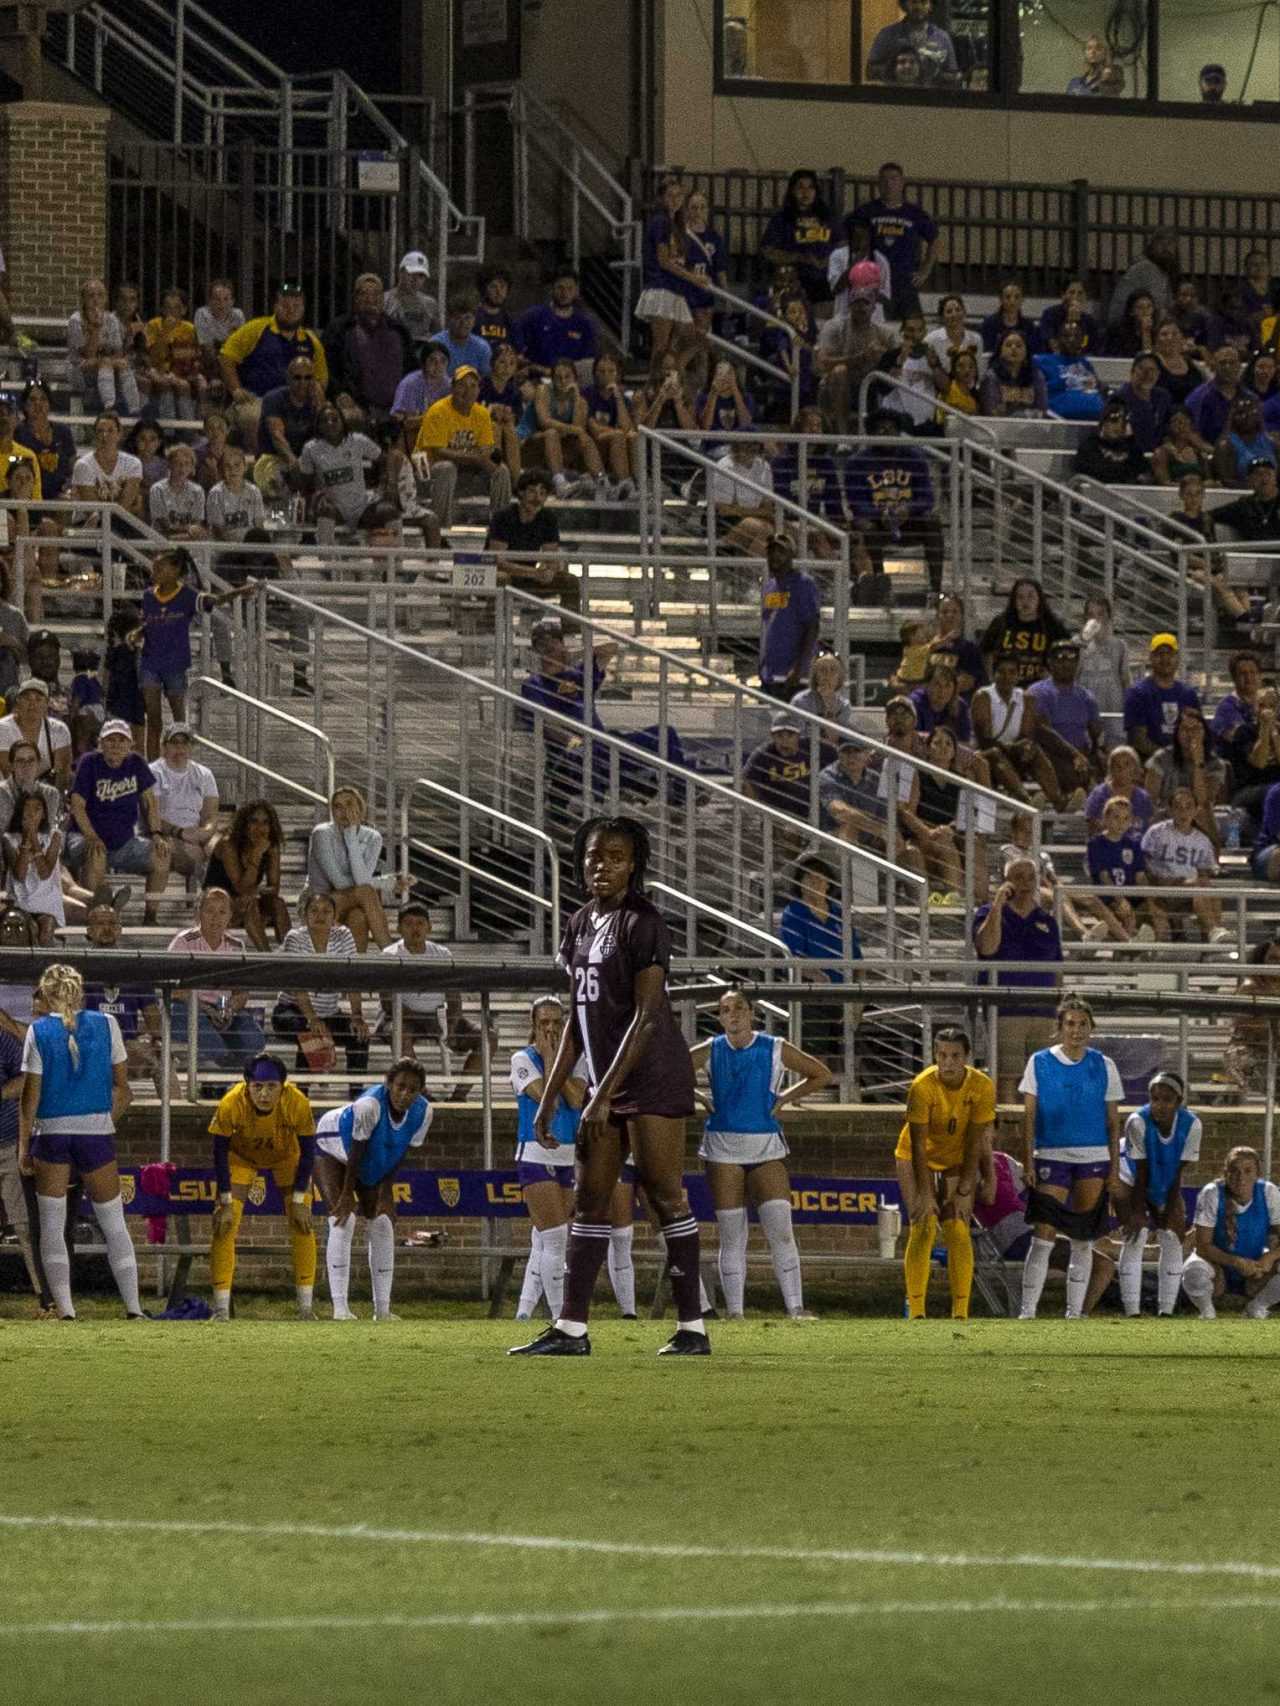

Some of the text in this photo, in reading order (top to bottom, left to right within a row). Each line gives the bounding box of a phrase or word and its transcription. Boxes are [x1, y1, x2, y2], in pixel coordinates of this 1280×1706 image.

[867, 468, 911, 490] LSU
[464, 574, 486, 586] 202
[1001, 630, 1048, 652] LSU
[96, 775, 138, 802] Tigers
[1159, 845, 1208, 867] LSU
[575, 966, 600, 1002] 26
[486, 1183, 526, 1204] LS
[790, 1190, 879, 1213] OCCER
